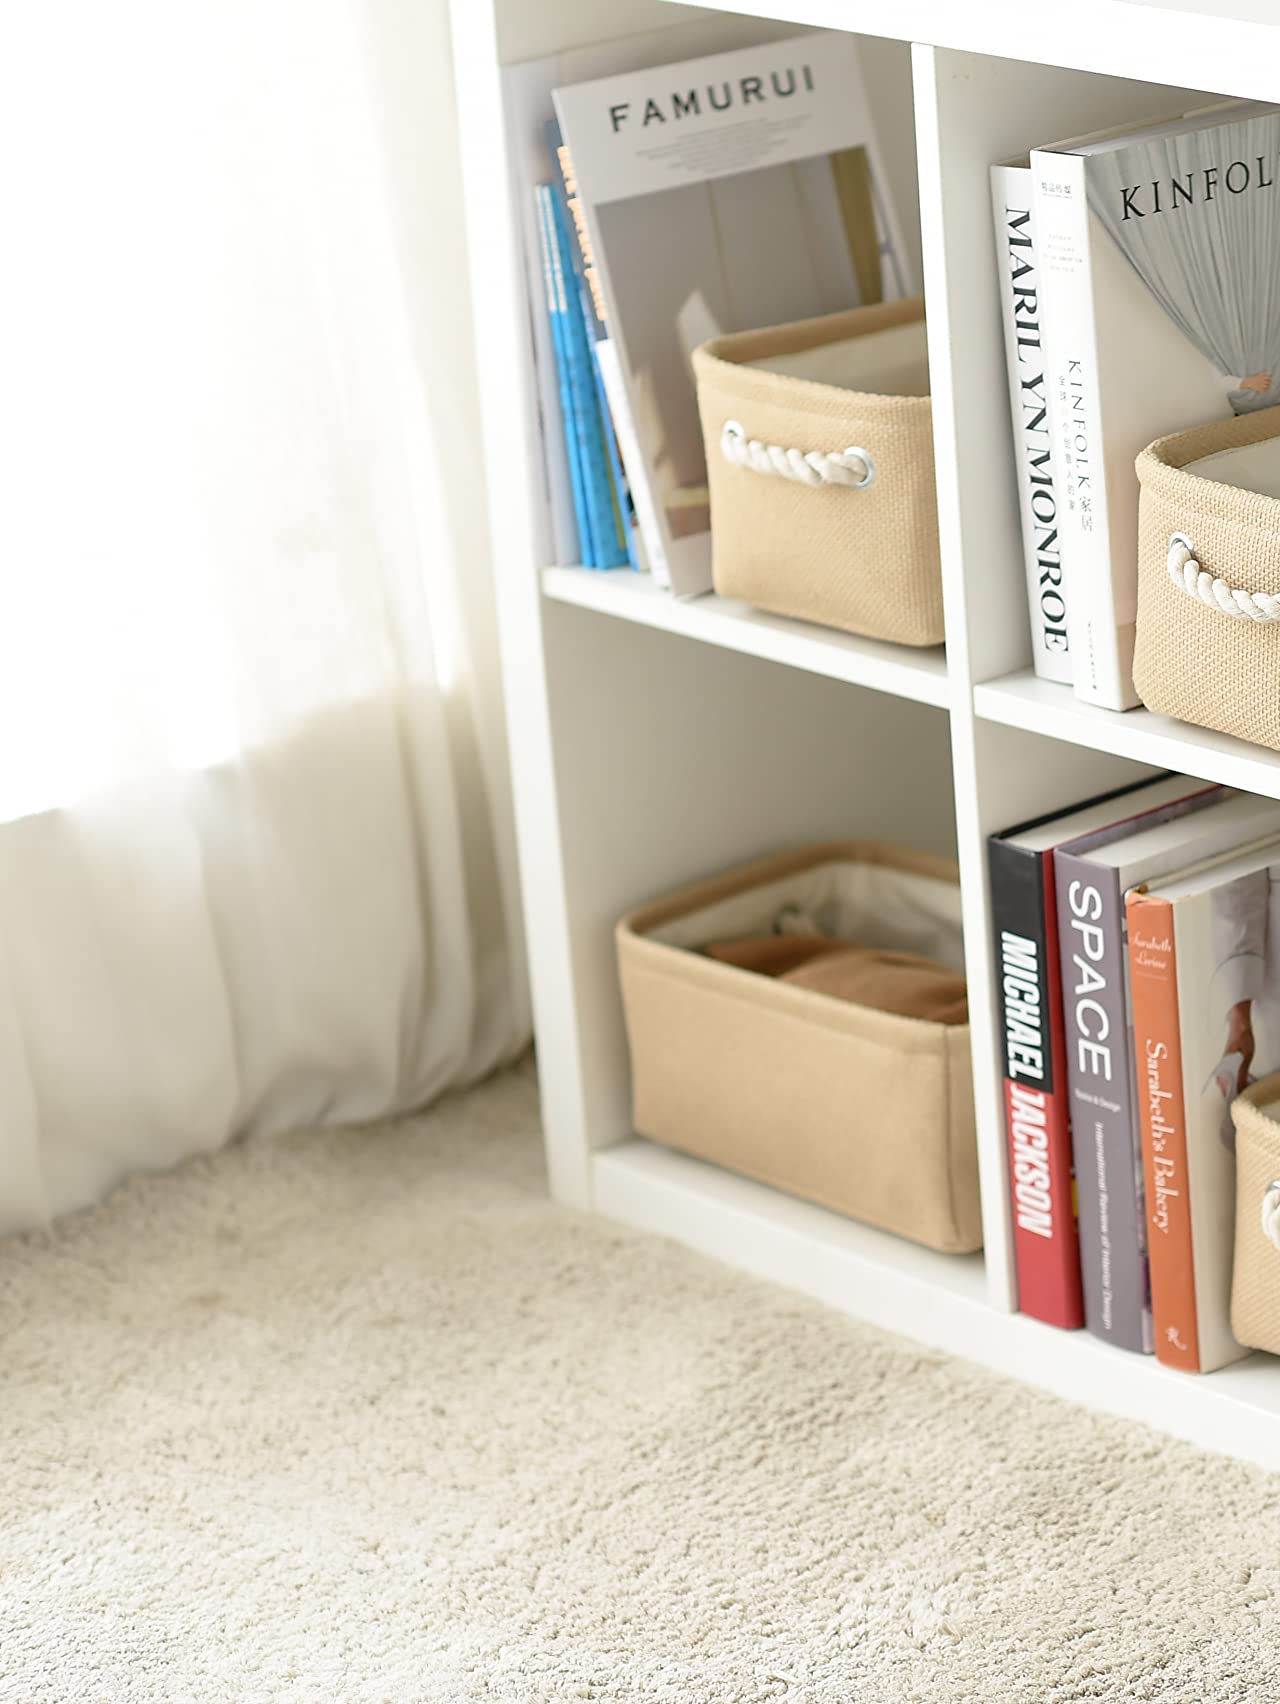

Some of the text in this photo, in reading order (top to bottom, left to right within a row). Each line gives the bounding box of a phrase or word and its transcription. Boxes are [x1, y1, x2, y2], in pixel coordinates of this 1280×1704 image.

[609, 64, 816, 133] FAMURUI
[1068, 360, 1091, 489] KINFOLK
[1026, 447, 1070, 653] MONROE
[1068, 880, 1112, 1083] SPACE
[1001, 931, 1053, 1239] MICHAEL JACKSON
[1153, 1154, 1180, 1234] Bakery
